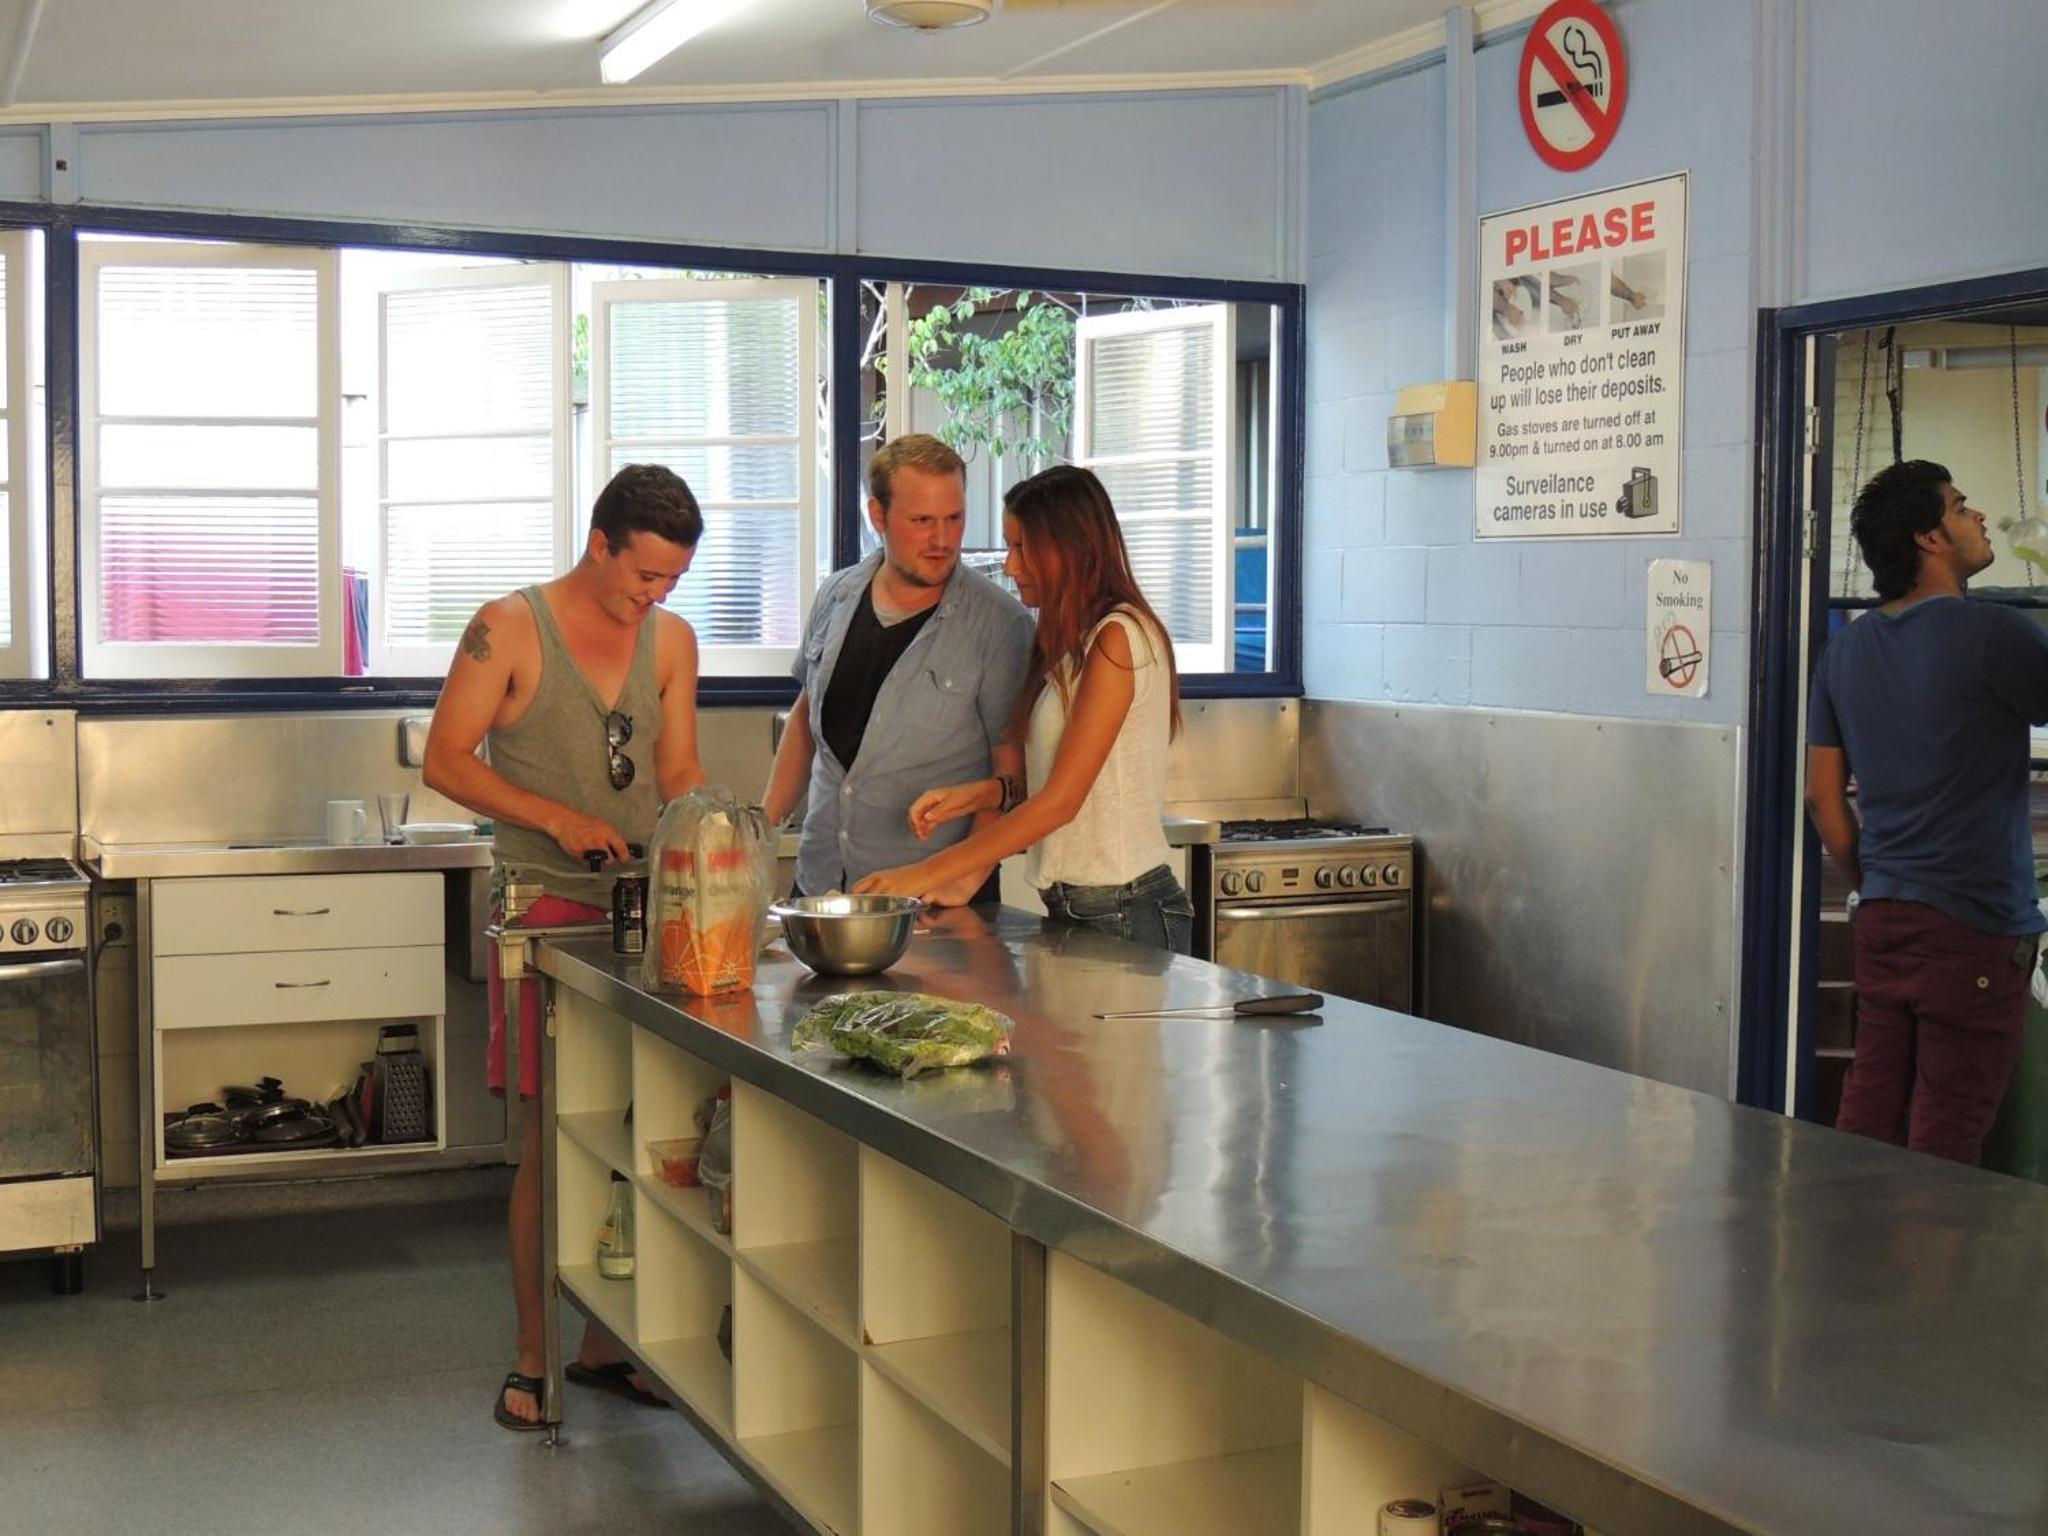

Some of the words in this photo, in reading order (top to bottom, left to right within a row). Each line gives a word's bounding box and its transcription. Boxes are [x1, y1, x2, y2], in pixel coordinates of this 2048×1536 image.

[1505, 201, 1655, 266] PLEASE
[1564, 335, 1582, 346] DRY
[1611, 327, 1630, 339] PUT
[1633, 322, 1661, 337] AWAY
[1502, 342, 1526, 354] WASH
[1501, 362, 1544, 383] People
[1549, 357, 1576, 376] who
[1580, 352, 1613, 373] don't
[1618, 350, 1655, 370] clean
[1490, 394, 1506, 412] up
[1511, 389, 1531, 407] will
[1535, 385, 1562, 405] lose
[1567, 381, 1597, 401] their
[1601, 375, 1666, 400] deposits.
[1497, 422, 1519, 437] Gas
[1522, 419, 1558, 435] stoves
[1561, 418, 1579, 431] are
[1583, 412, 1621, 429] turned
[1625, 410, 1640, 425] off
[1644, 411, 1655, 423] at
[1489, 442, 1528, 460] 9.00pm
[1532, 440, 1540, 455] &
[1543, 436, 1580, 453] turned
[1584, 437, 1598, 451] on
[1601, 435, 1613, 449] at
[1616, 433, 1642, 448] 8.00
[1645, 433, 1663, 446] am
[1506, 474, 1594, 496] Surveilance
[1494, 499, 1555, 521] cameras
[1561, 499, 1573, 518] in
[1579, 501, 1607, 518] use
[1673, 570, 1688, 584] No
[1656, 592, 1703, 609] Smoking
